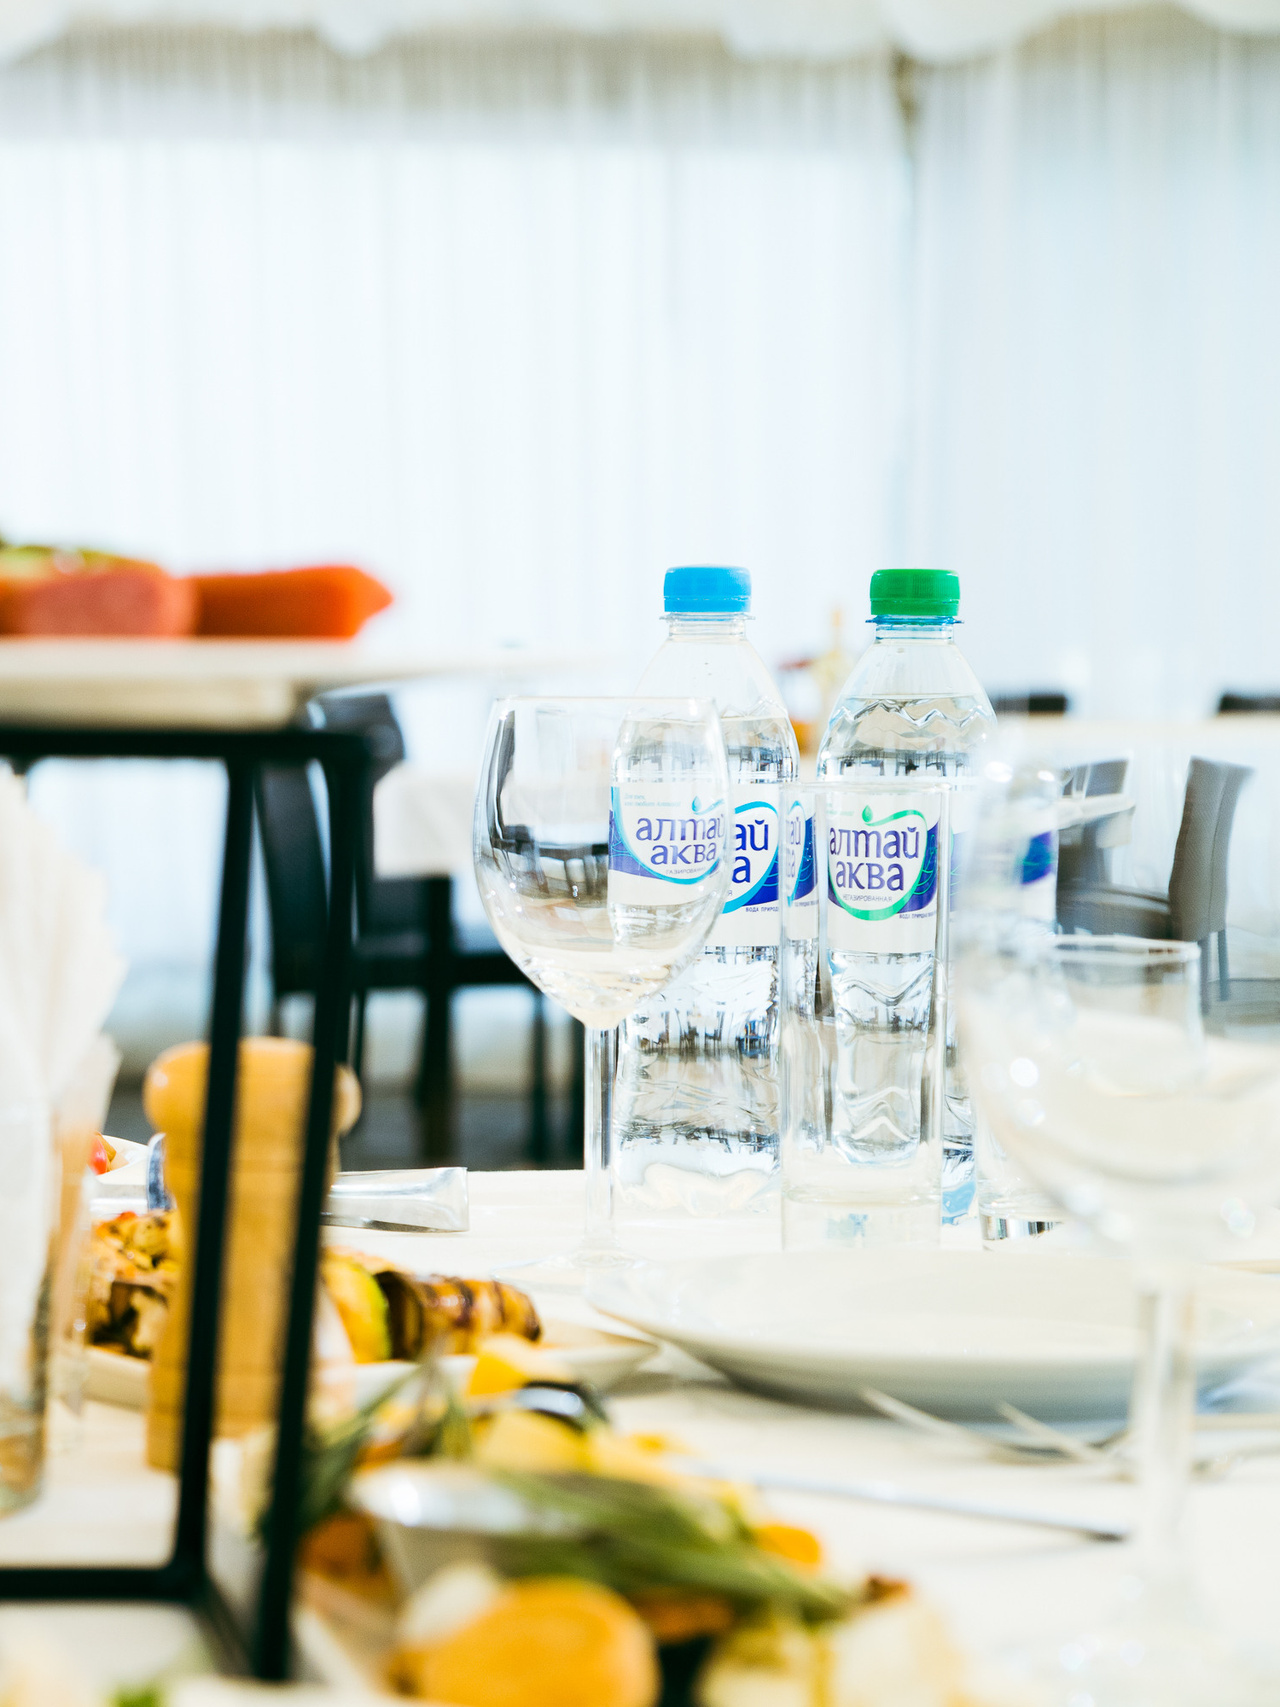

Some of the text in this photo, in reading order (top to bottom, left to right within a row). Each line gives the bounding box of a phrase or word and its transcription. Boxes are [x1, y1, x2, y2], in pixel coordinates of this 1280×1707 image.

[650, 842, 717, 865] аква
[829, 826, 919, 859] алтай
[835, 860, 904, 891] аква
